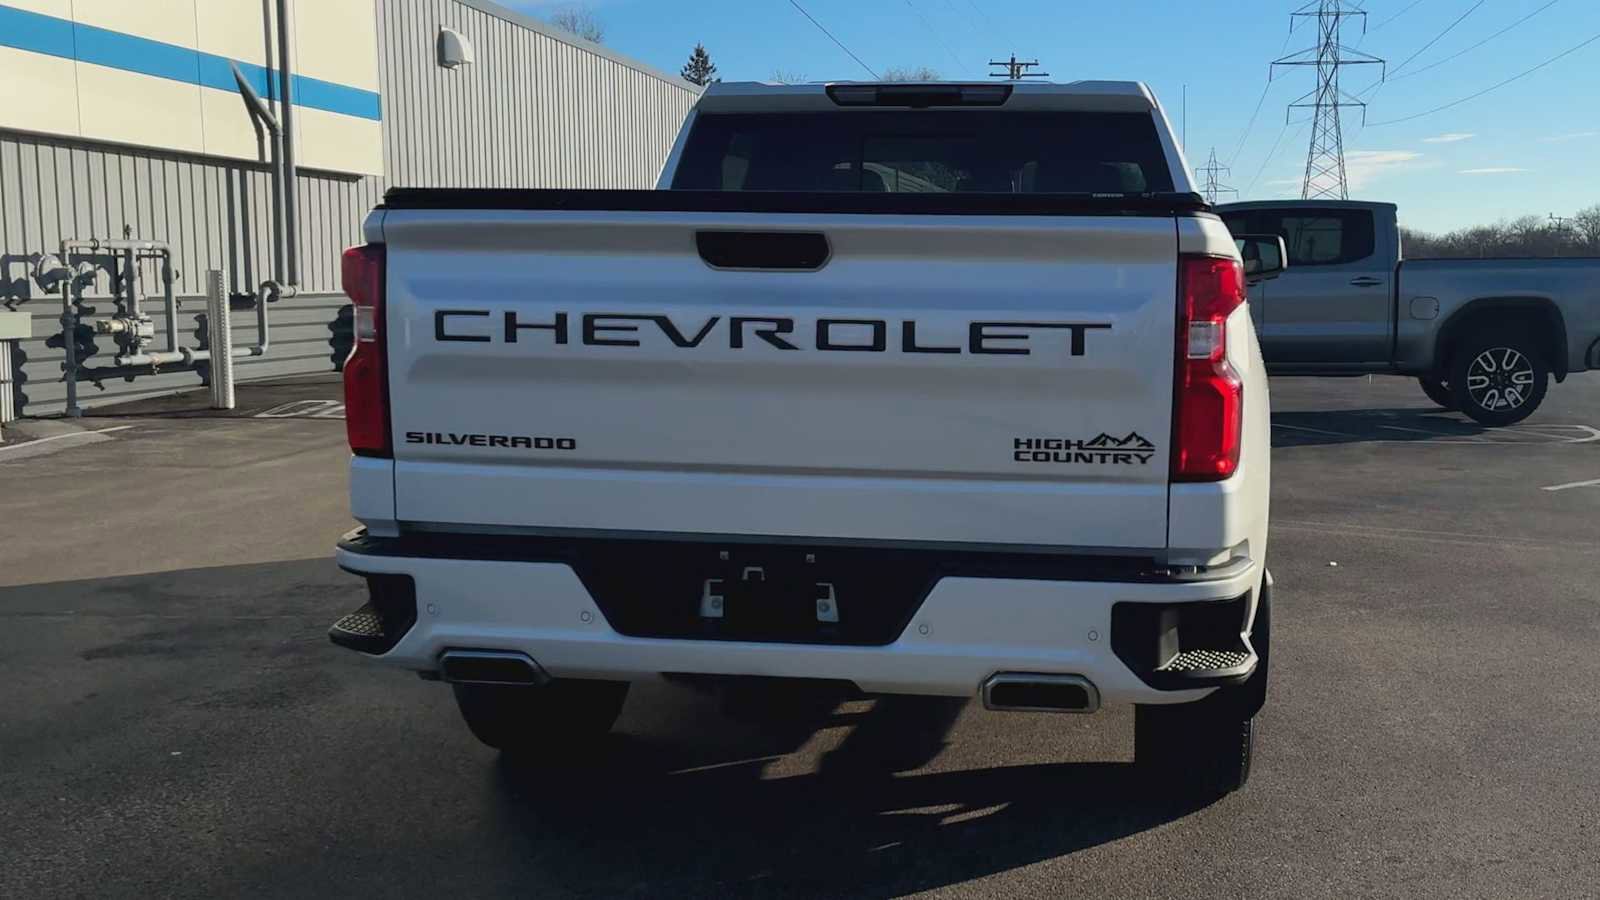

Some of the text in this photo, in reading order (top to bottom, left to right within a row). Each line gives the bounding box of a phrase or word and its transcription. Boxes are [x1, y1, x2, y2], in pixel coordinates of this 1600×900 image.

[434, 310, 1112, 356] CHEVROLET
[406, 432, 576, 449] SILVERADO
[1014, 438, 1083, 450] HIGH
[1014, 451, 1154, 464] COUNTRY
